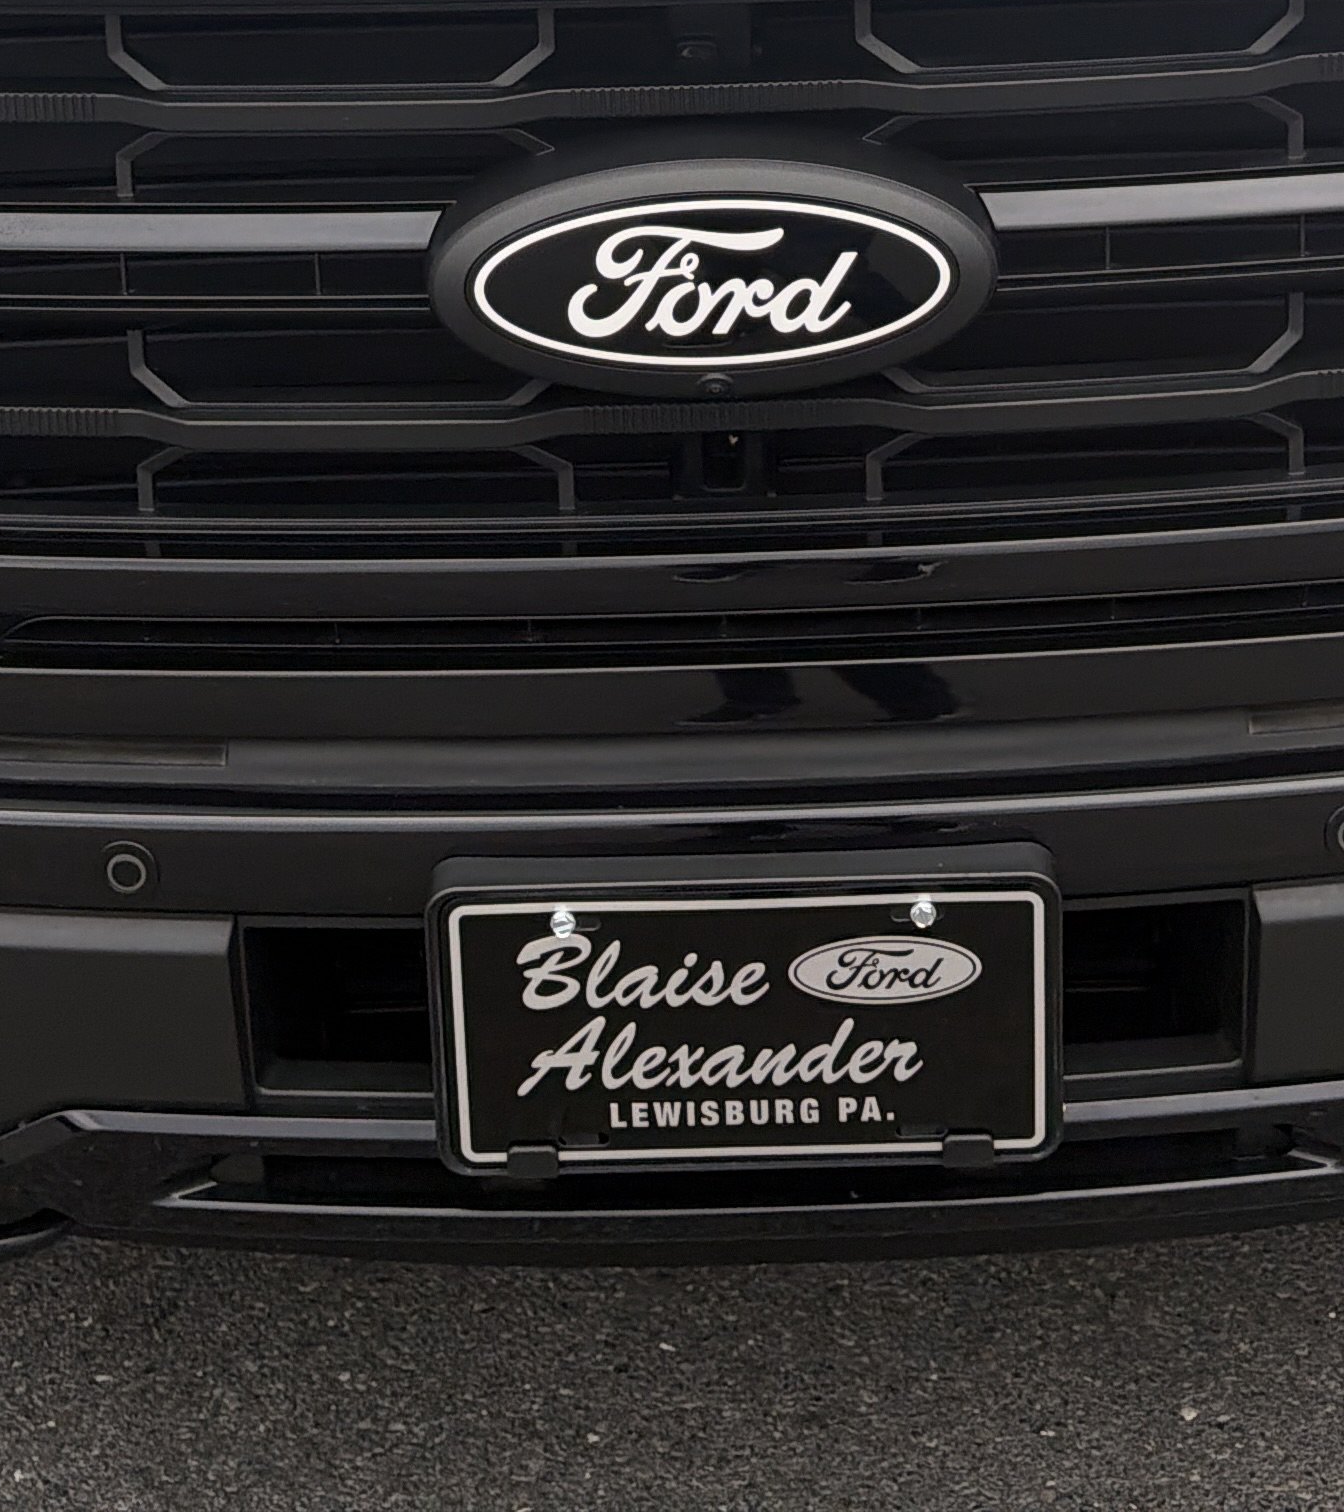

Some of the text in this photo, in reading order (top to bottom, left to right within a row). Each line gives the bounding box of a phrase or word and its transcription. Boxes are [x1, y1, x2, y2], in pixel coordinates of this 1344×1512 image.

[567, 225, 859, 339] Ford
[515, 932, 771, 1011] Blaise
[825, 947, 946, 992] Ford
[516, 1015, 924, 1098] Alexander
[609, 1094, 896, 1130] LEWISBURG PA.
